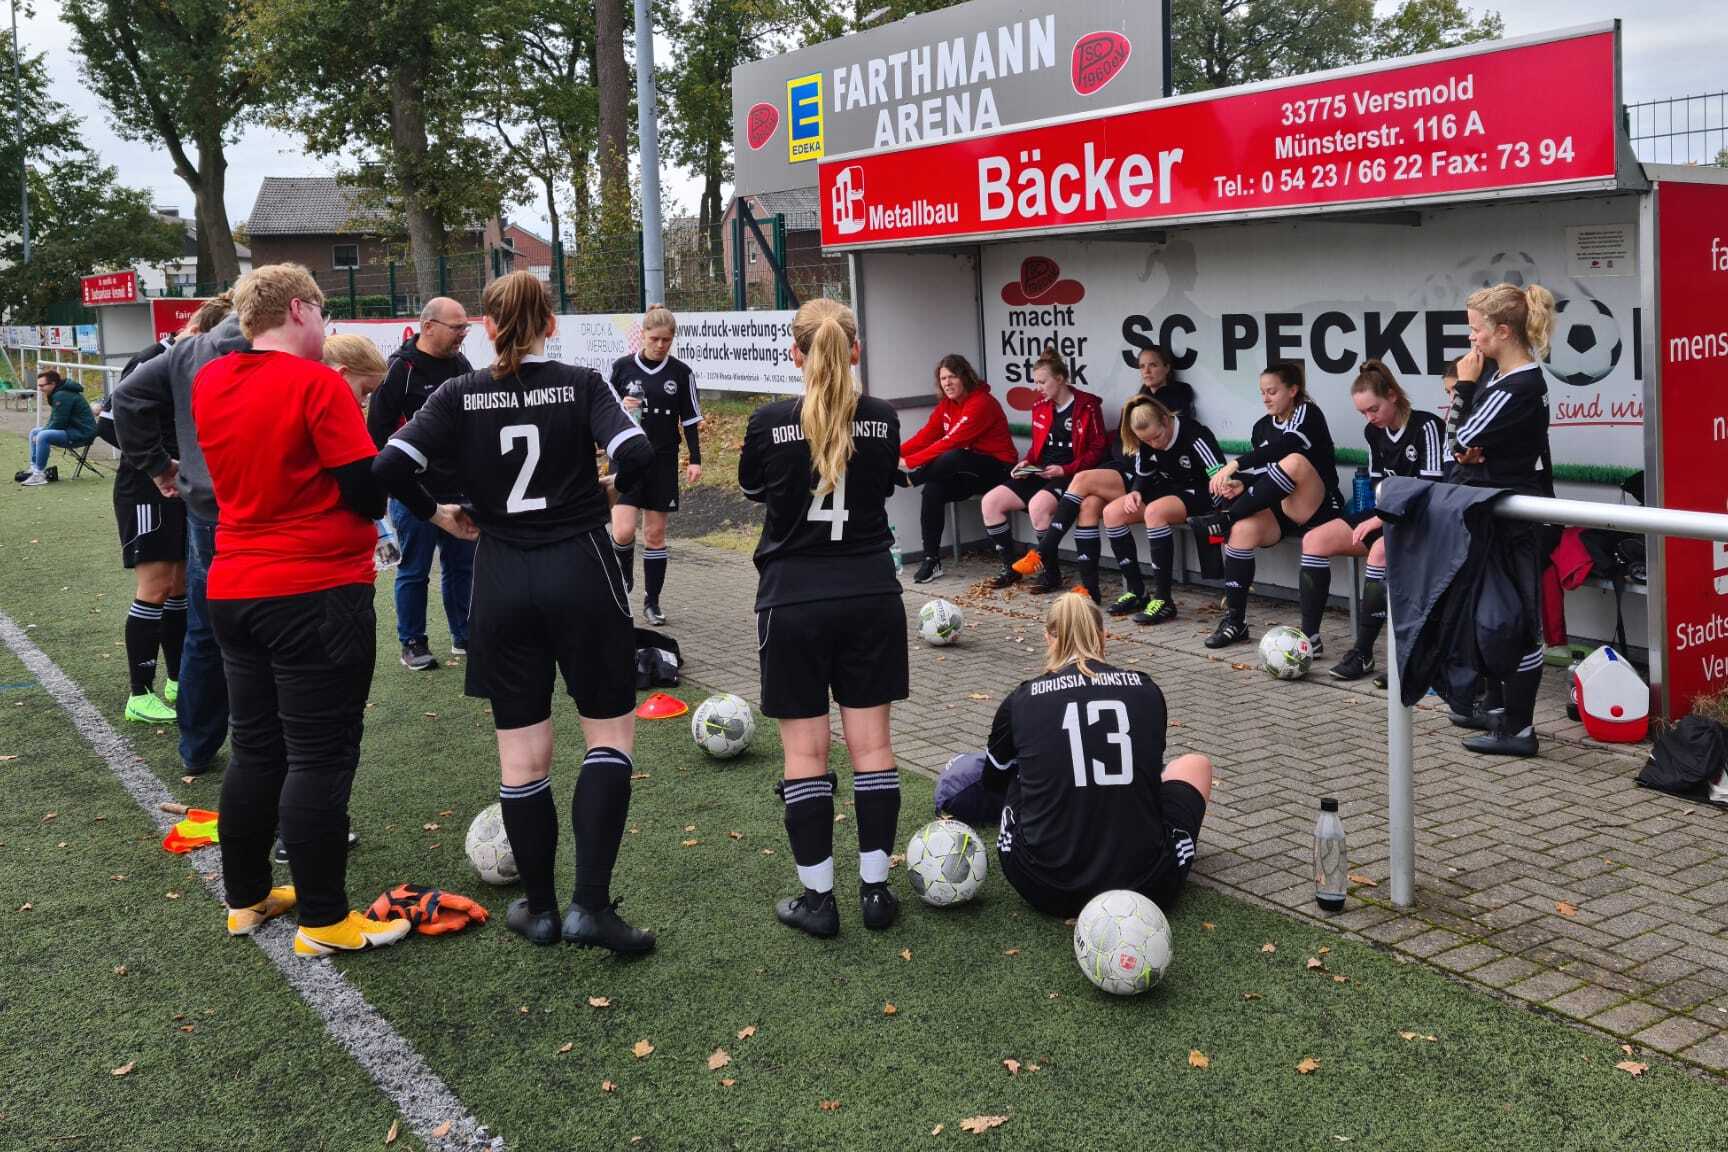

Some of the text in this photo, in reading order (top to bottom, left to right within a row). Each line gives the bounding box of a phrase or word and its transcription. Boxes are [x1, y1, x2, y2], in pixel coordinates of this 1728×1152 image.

[833, 14, 1056, 113] FARTHMANN
[873, 87, 1001, 147] ARENA
[1281, 74, 1474, 126] 33775 Versmold
[792, 141, 821, 156] EDEKA
[1274, 110, 1485, 160] Münsterstr. 116 A
[869, 141, 1184, 230] Metallbau Bäcker
[1214, 174, 1255, 198] Tel.:
[1261, 171, 1273, 194] 0
[1280, 168, 1304, 192] 54
[1311, 165, 1337, 189] 23
[1358, 157, 1386, 184] 66
[1394, 154, 1423, 181] 22
[1432, 148, 1488, 177] Fax:
[1498, 144, 1530, 170] 73
[1540, 136, 1574, 165] 94
[677, 319, 794, 341] www.druck-werbung-sc
[1009, 305, 1075, 327] macht
[1122, 313, 1198, 371] SC
[1001, 330, 1088, 357] Kinder
[1005, 357, 1088, 385] stk
[464, 391, 519, 411] BORUSSIA
[500, 424, 547, 513] 2
[807, 466, 849, 541] 4
[1031, 674, 1086, 696] BORUSSIA
[1062, 699, 1134, 787] 13
